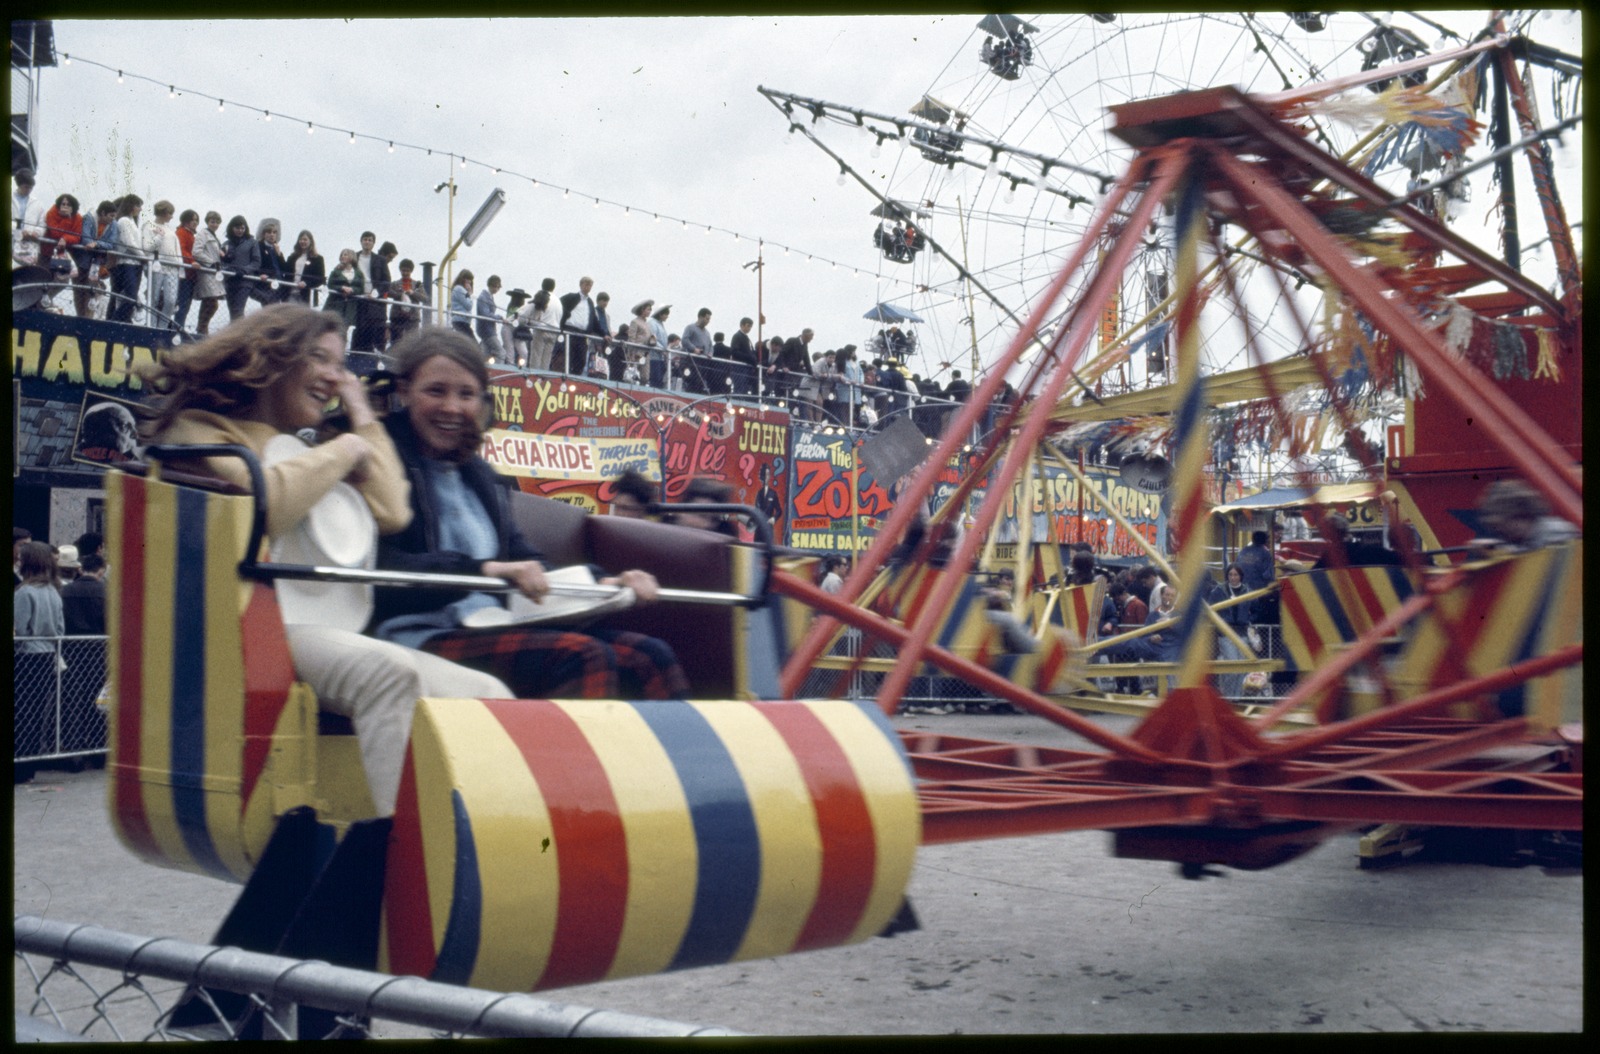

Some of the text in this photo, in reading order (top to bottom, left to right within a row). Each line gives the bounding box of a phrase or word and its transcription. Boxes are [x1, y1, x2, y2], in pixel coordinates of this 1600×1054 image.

[534, 380, 570, 421] You
[574, 388, 610, 418] must
[583, 416, 598, 426] THE
[579, 425, 626, 438] INCREDIBLE
[739, 420, 786, 456] JOHN
[800, 432, 814, 444] IN
[545, 442, 594, 471] RIDE
[598, 443, 649, 461] THRILLS
[794, 442, 829, 459] PERSON
[826, 440, 852, 469] The
[791, 531, 834, 549] SNAKE
